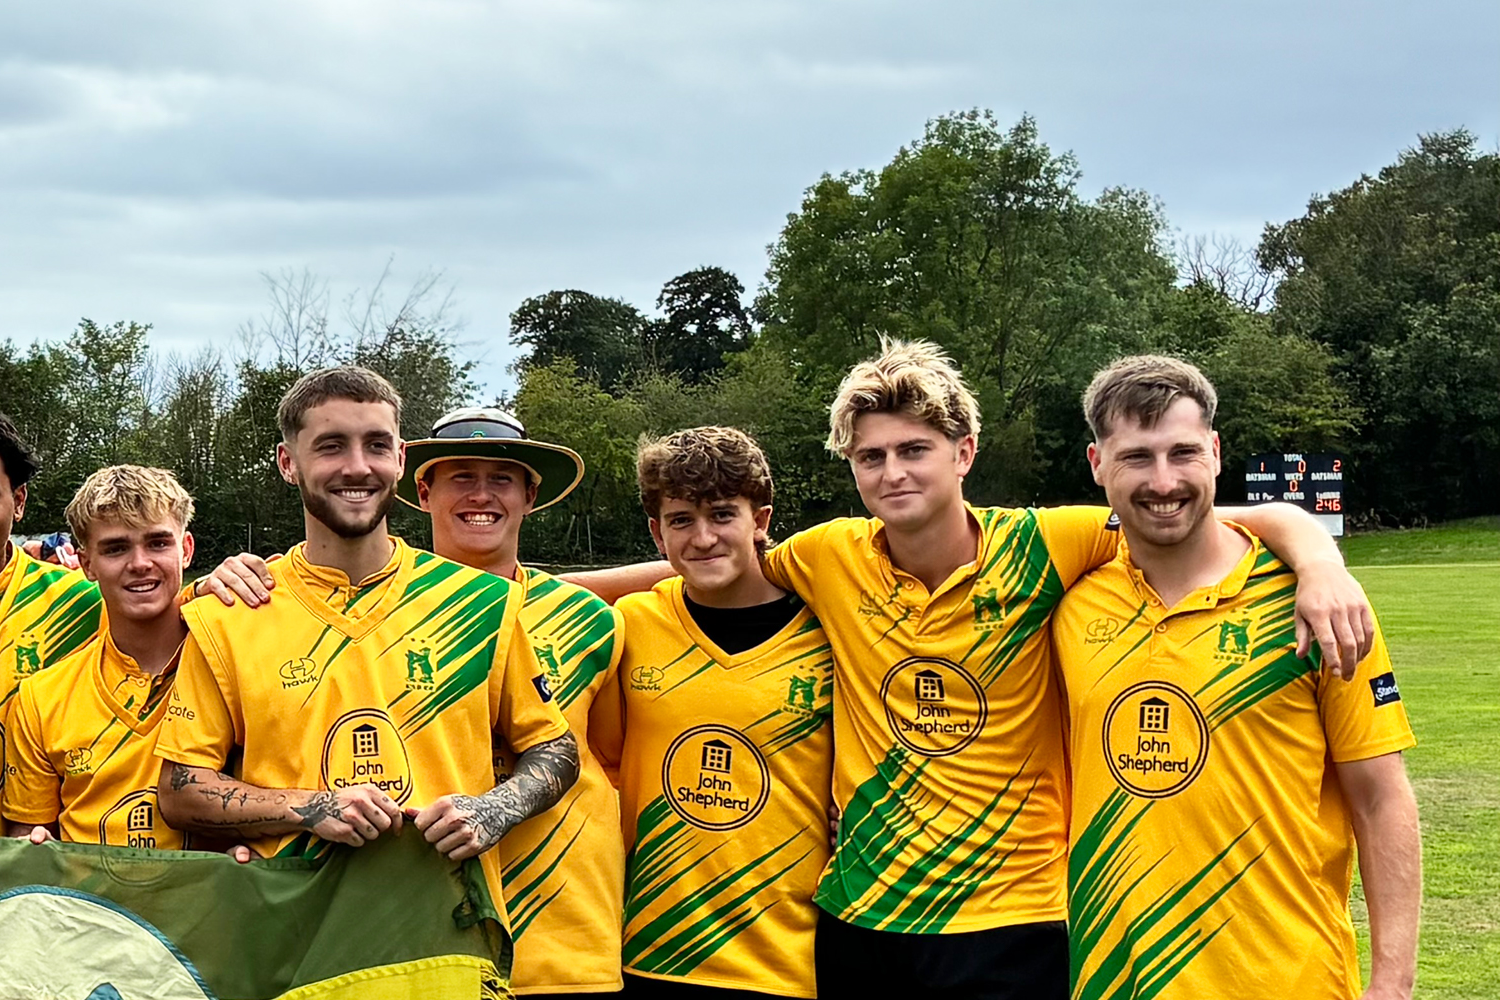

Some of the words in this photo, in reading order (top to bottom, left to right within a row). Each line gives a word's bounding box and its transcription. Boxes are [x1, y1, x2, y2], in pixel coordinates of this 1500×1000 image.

[1298, 460, 1306, 473] 0
[1332, 460, 1341, 472] 2
[1289, 480, 1298, 492] 0
[1315, 499, 1341, 512] 246
[282, 674, 319, 689] hawk
[630, 683, 662, 691] hawk
[915, 702, 951, 720] John
[901, 718, 970, 735] Shepherd
[1136, 735, 1170, 756] John
[352, 760, 384, 780] John
[1118, 754, 1189, 775] Shepherd
[696, 772, 732, 792] John
[677, 786, 749, 812] Shepherd
